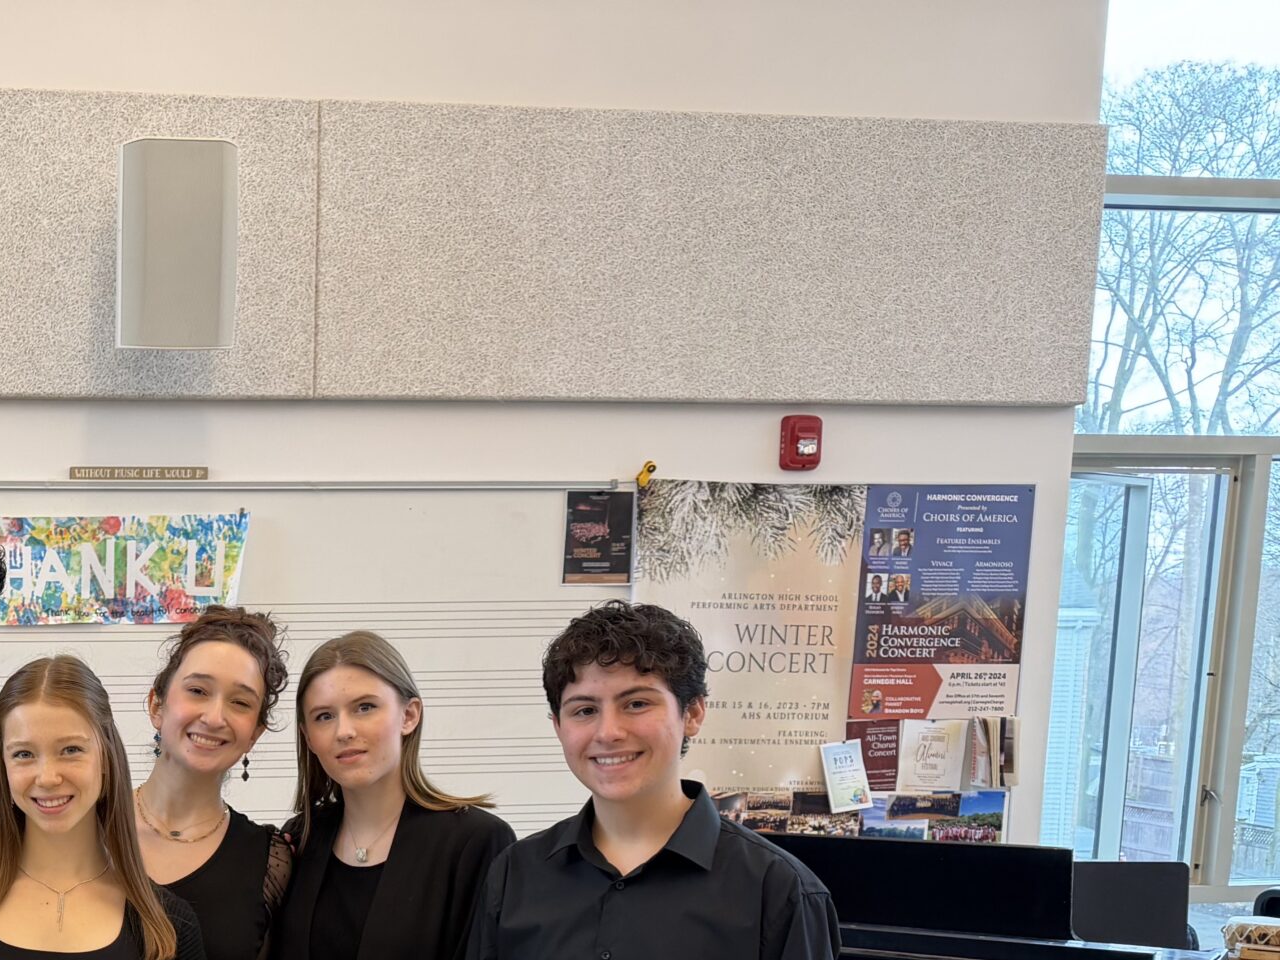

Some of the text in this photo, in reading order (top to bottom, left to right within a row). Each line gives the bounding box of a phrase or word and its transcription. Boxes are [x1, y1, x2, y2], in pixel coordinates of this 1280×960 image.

[74, 468, 111, 479] WITHOUT
[114, 468, 141, 479] MUSIC
[142, 468, 161, 479] LIFE
[165, 468, 193, 479] WOULD
[926, 494, 1019, 502] HARMONIC CONVERGENCE
[4, 539, 226, 600] HANK U
[721, 593, 775, 601] ARLINGTON
[778, 594, 801, 602] HIGH
[690, 602, 839, 612] PERFORMING ARTS DEPARTMENT
[46, 608, 71, 617] Thank
[75, 609, 90, 618] you
[94, 609, 107, 617] for
[111, 610, 126, 618] the
[735, 623, 836, 646] WINTER
[866, 624, 880, 658] 2024
[706, 650, 835, 674] CONCERT
[950, 672, 973, 680] APRIL
[988, 672, 1007, 680] 2024
[732, 701, 743, 709] 15
[747, 701, 754, 709] &
[759, 702, 773, 710] 16,
[811, 702, 830, 710] 7PM
[741, 712, 830, 721] AHS AUDITORIUM
[778, 730, 829, 738] FEATURING:
[865, 734, 898, 742] All-Town
